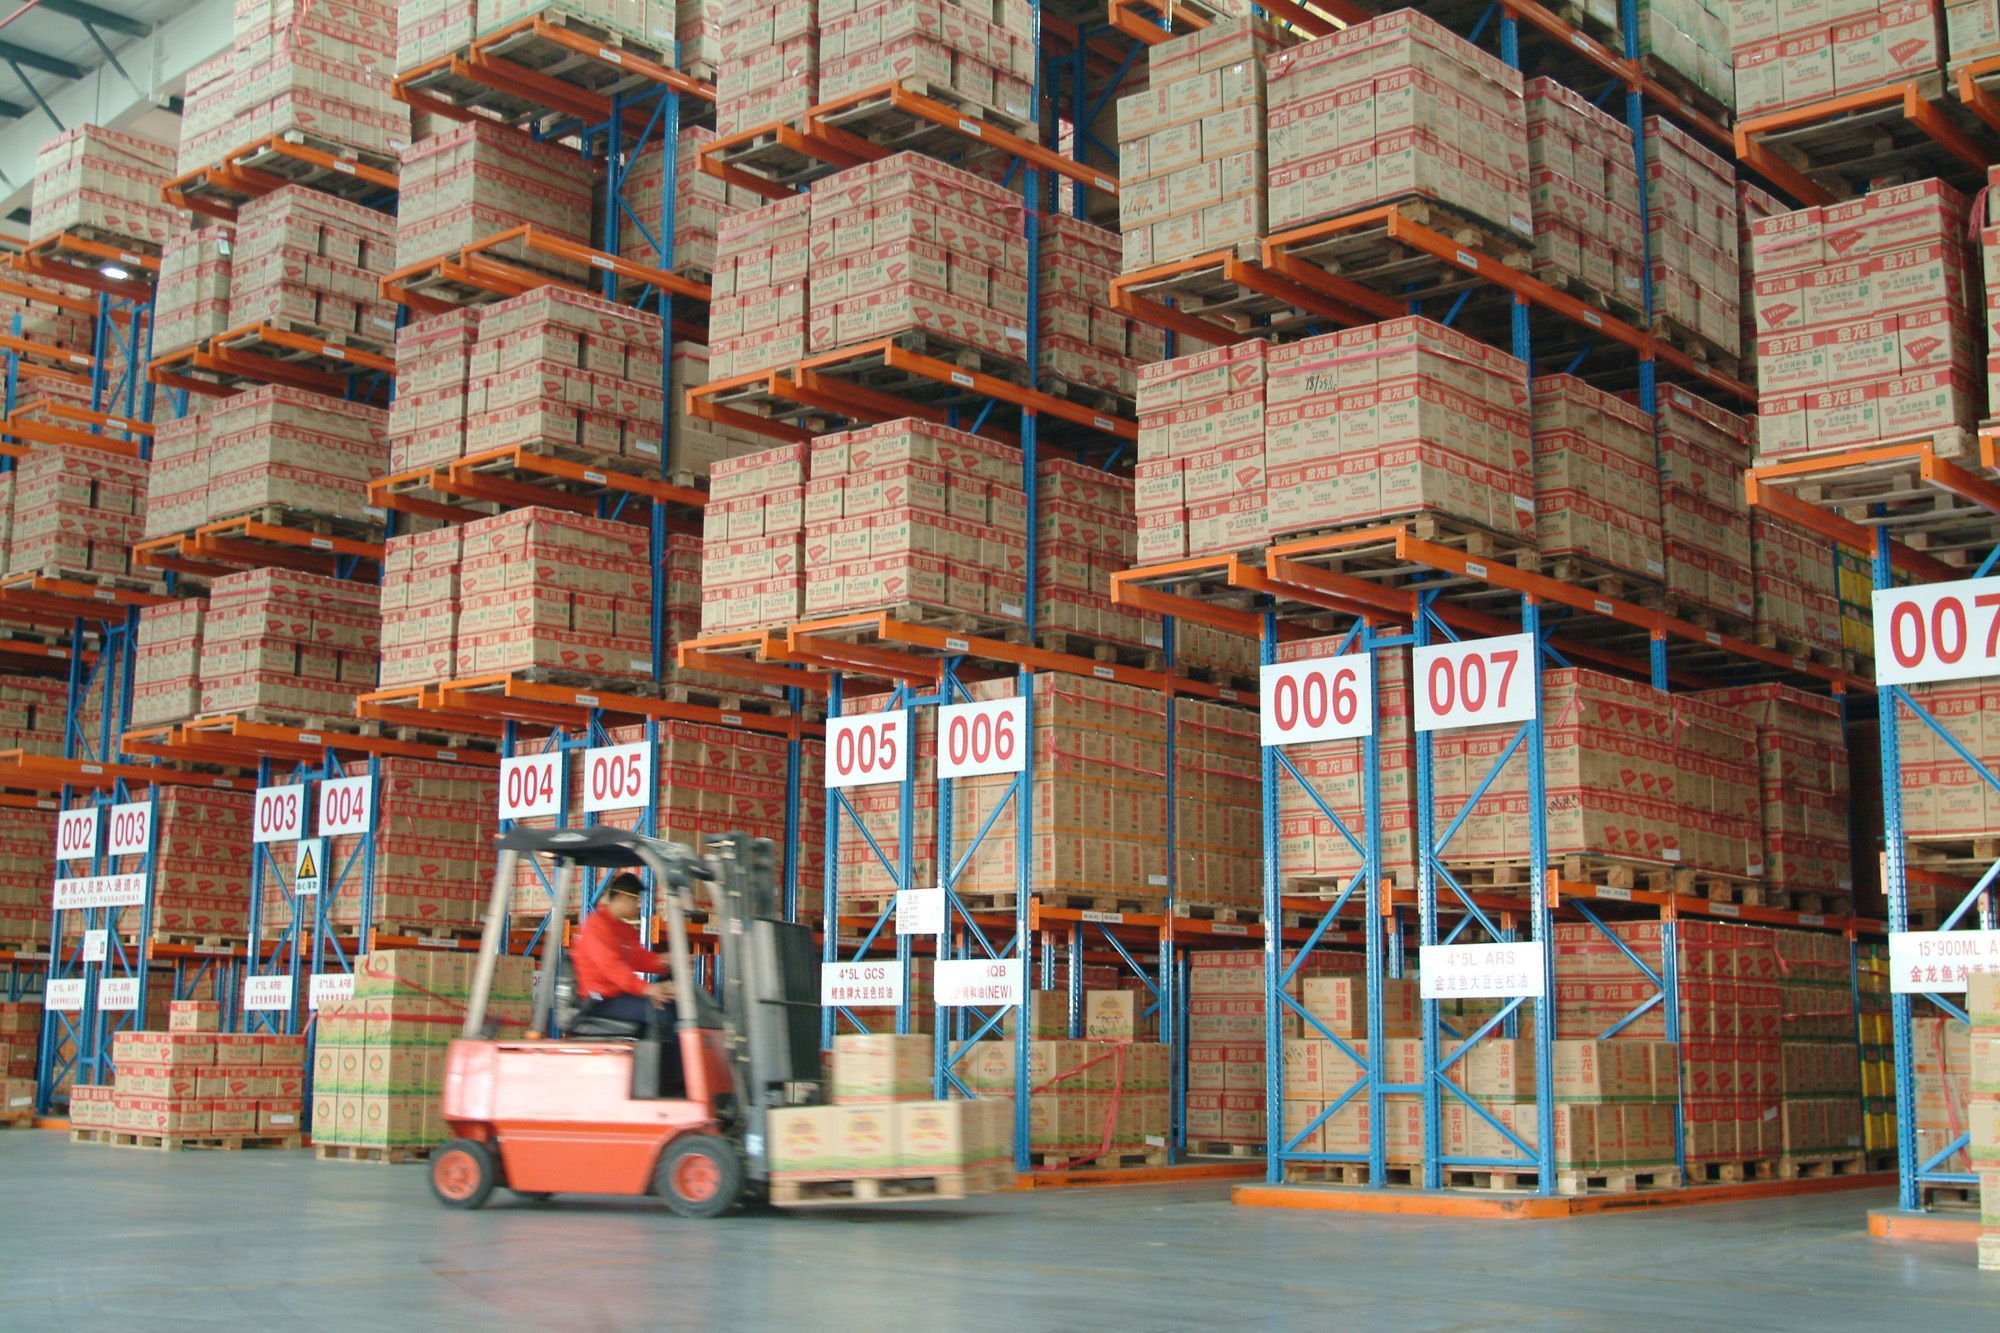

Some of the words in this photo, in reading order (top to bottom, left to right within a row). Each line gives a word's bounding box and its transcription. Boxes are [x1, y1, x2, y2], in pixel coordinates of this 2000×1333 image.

[1887, 3, 1928, 26] 金龙鱼
[1838, 20, 1878, 41] 金龙鱼
[1786, 35, 1827, 55] 金龙鱼
[1878, 185, 1925, 207] 金龙鱼
[1764, 213, 1808, 234] 金龙鱼
[1883, 248, 1931, 271] 金龙鱼
[1814, 265, 1860, 285] 金龙鱼
[1837, 322, 1884, 342] 金龙鱼
[1768, 335, 1814, 355] 金龙鱼
[1888, 375, 1936, 396] 金龙鱼
[1818, 388, 1864, 408] 金龙鱼
[1890, 593, 2000, 669] 007
[1428, 650, 1518, 716] 007
[1274, 668, 1357, 731] 006
[1936, 700, 1976, 713] 金龙鱼
[949, 710, 1014, 765] 006
[1468, 741, 1499, 753] 金龙鱼
[836, 722, 896, 776] 005
[1315, 757, 1354, 774] 金龙鱼
[1939, 770, 1978, 782] 金龙鱼
[508, 764, 553, 808] 004
[593, 753, 641, 801] 005
[261, 794, 296, 832] 003
[327, 787, 363, 825] 004
[63, 817, 92, 851] 002
[115, 811, 145, 846] 003
[100, 895, 139, 903] PASSAGEWAY
[1486, 951, 1515, 966] ARS
[864, 968, 885, 980] GCS
[1436, 973, 1528, 991] 金龙鱼大豆色拉油
[831, 986, 893, 1000] 鲤鱼牌大豆色拉油
[1592, 985, 1632, 999] 金龙鱼
[1500, 1044, 1510, 1078] 金龙鱼
[1582, 1045, 1593, 1084] 金龙鱼
[1452, 1108, 1462, 1143] 金龙鱼
[1554, 1110, 1565, 1150] 金龙鱼
